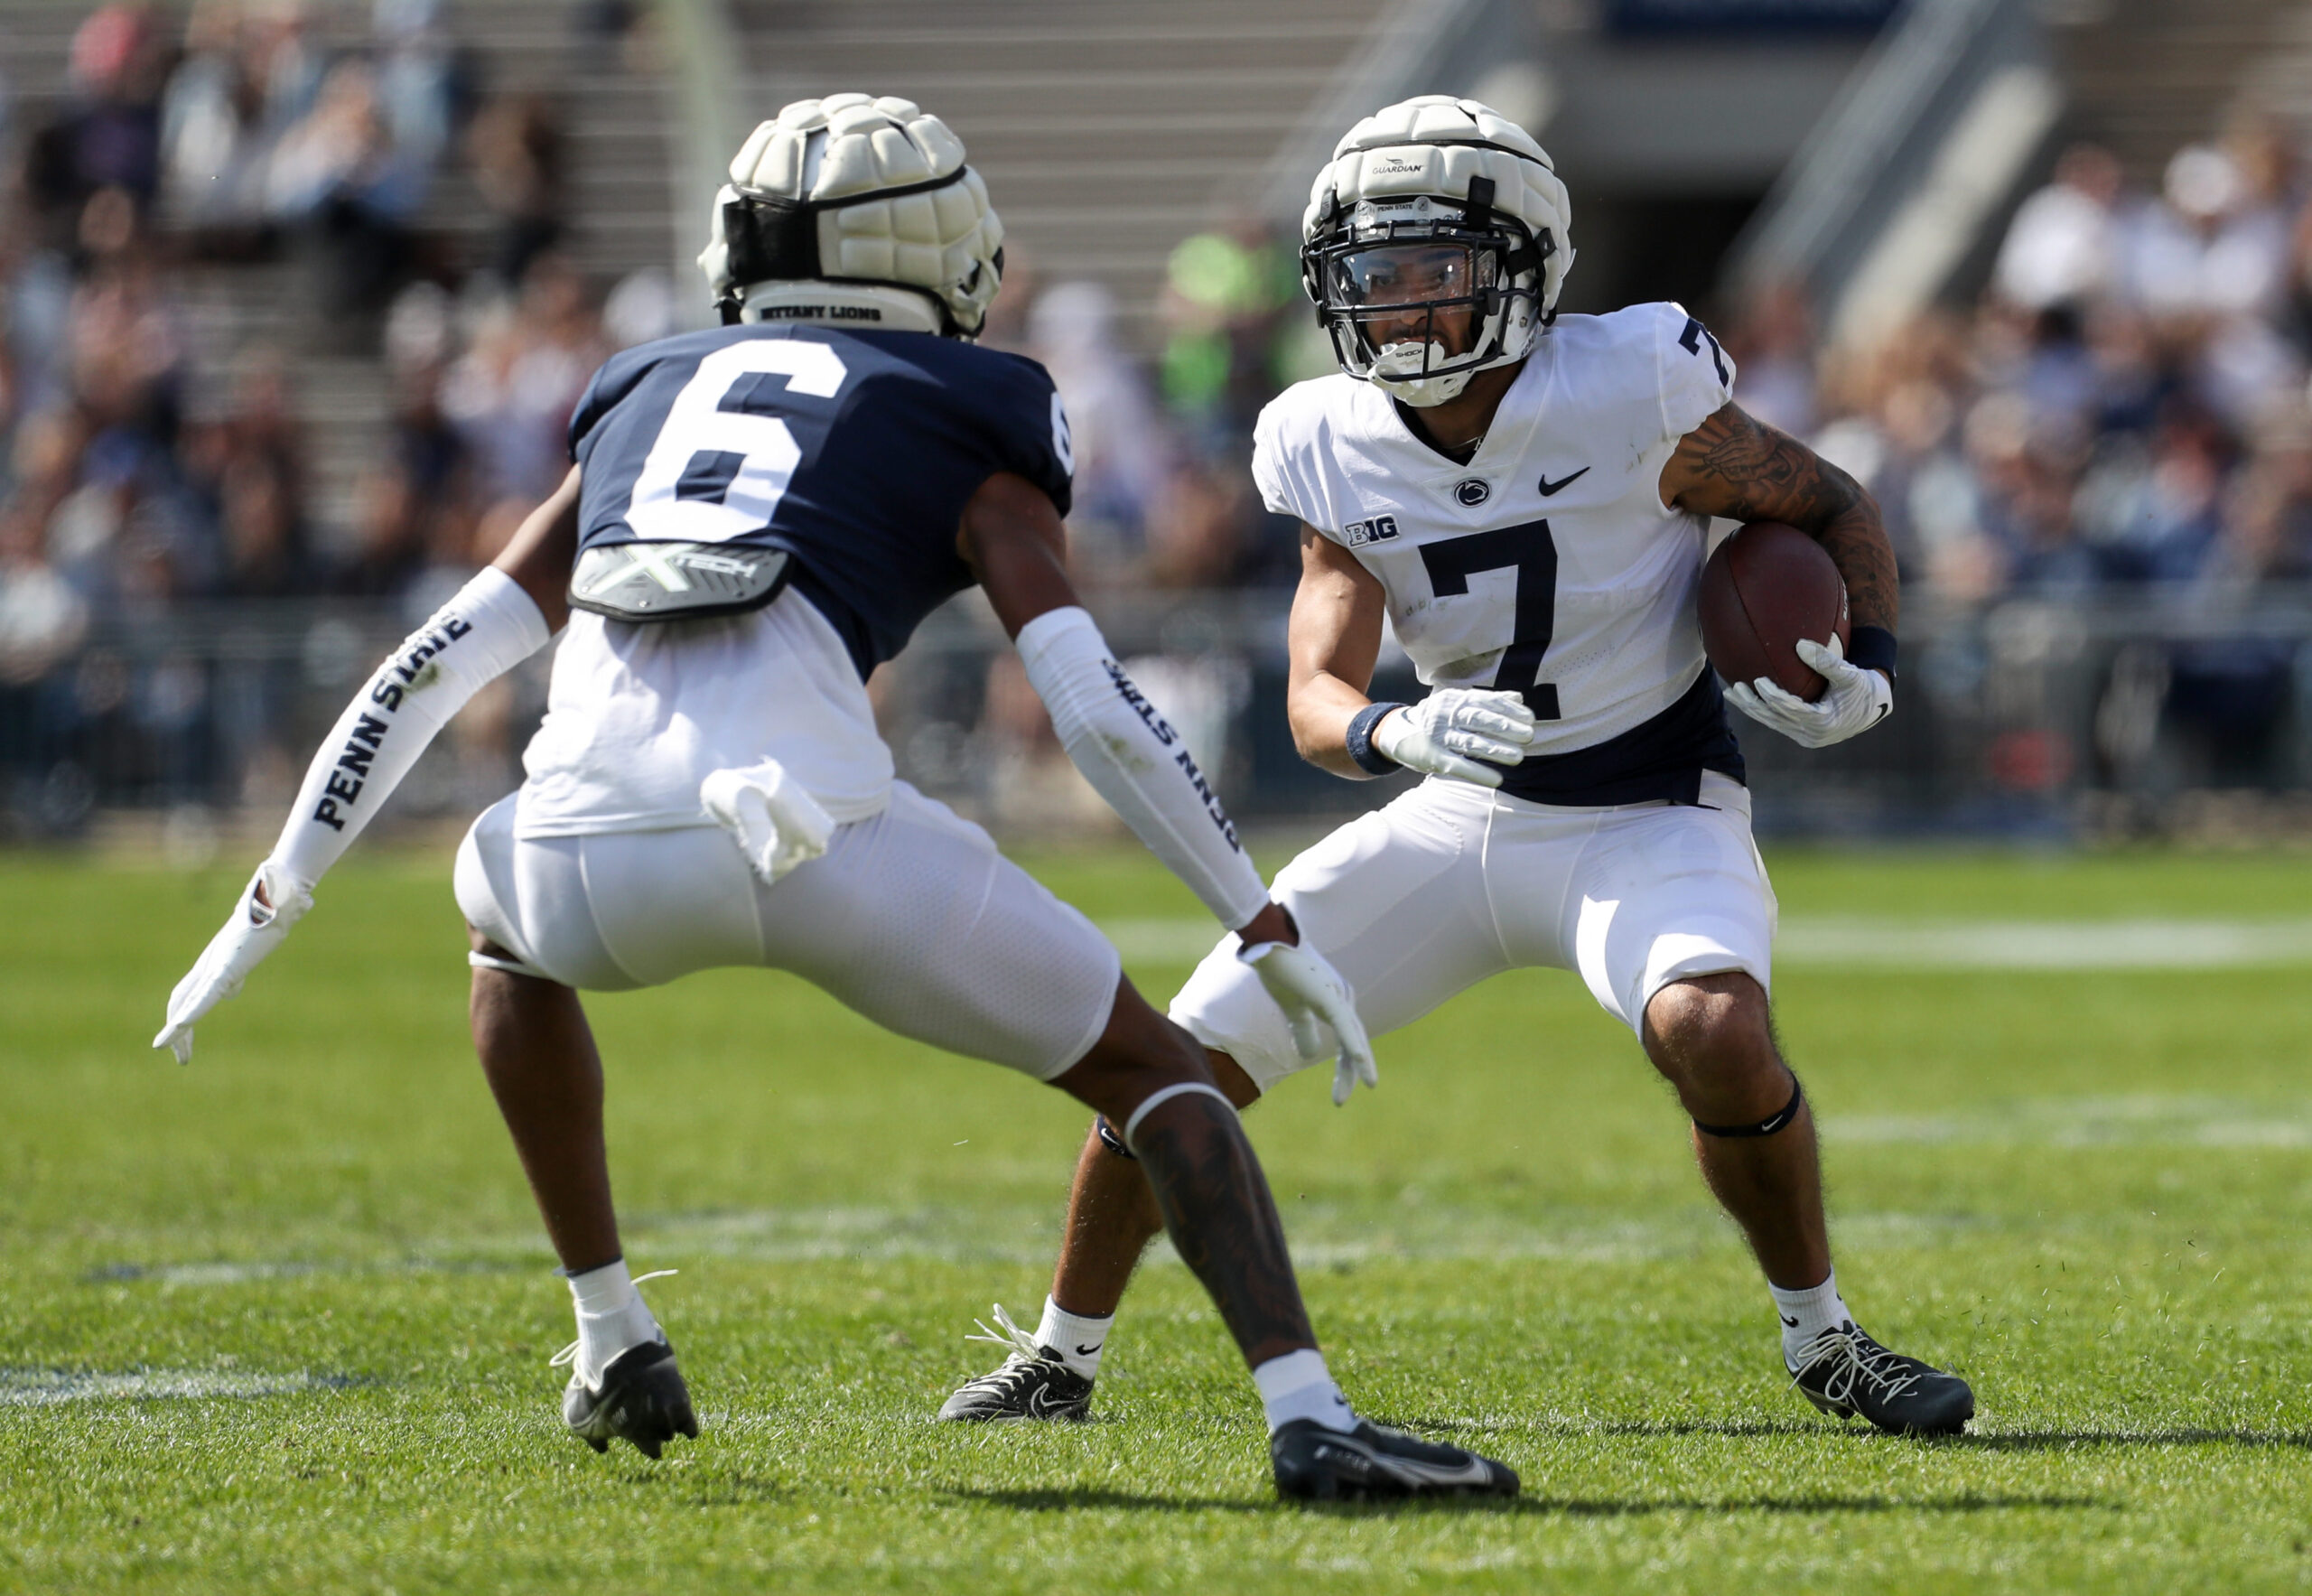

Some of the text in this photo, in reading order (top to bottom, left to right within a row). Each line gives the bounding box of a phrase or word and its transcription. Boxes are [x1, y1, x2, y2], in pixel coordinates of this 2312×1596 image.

[1372, 164, 1422, 174] GUARDIAN
[830, 305, 882, 322] LIONS
[1395, 348, 1423, 359] SHOCK
[623, 339, 848, 543] 6
[1418, 518, 1562, 721] 7
[312, 712, 389, 833] PENN
